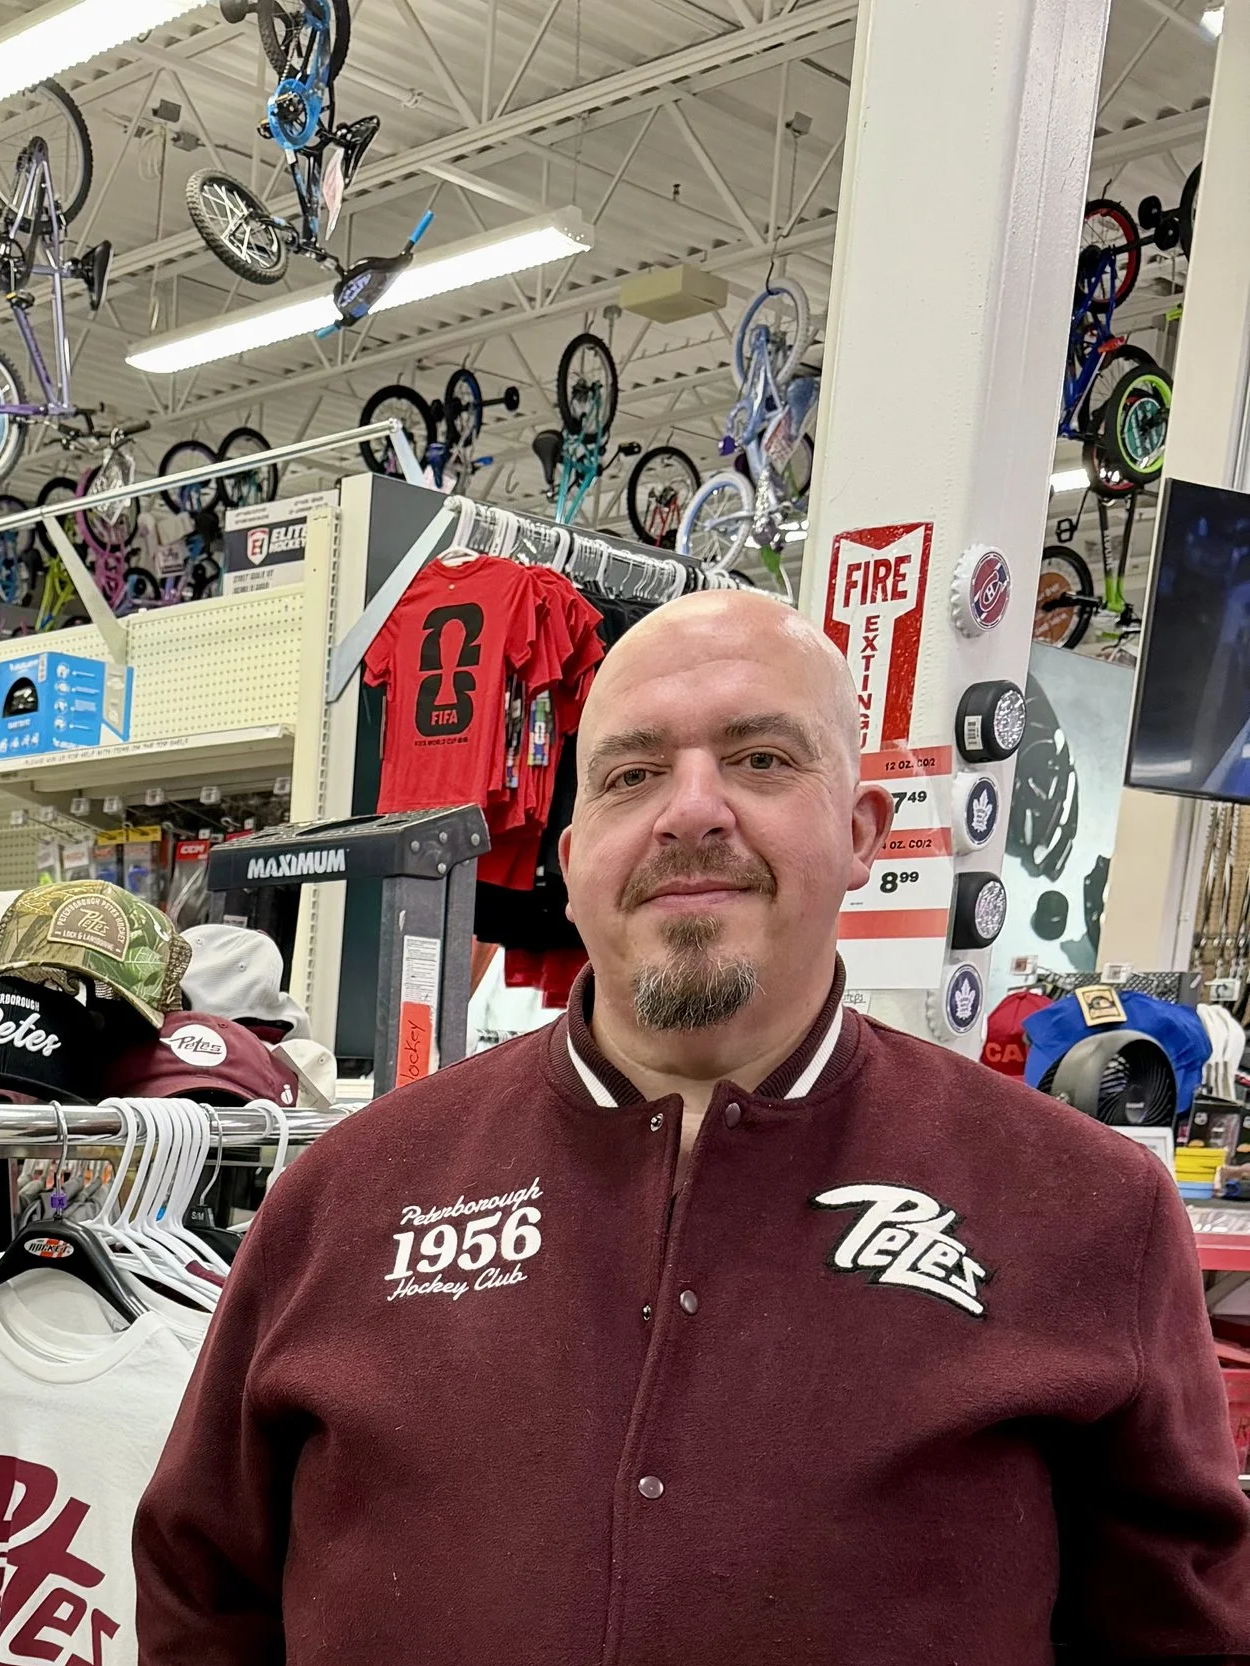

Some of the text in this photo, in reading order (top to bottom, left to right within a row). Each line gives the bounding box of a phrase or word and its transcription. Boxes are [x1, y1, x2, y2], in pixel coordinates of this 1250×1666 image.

[843, 554, 912, 608] FIRE
[430, 709, 458, 726] FIFA
[885, 762, 896, 772] 12
[898, 760, 914, 770] OZ.
[890, 839, 932, 850] OZ. CO/2
[247, 849, 347, 879] MAXIMUM
[57, 897, 100, 926] PETERBOROUGH
[400, 1177, 543, 1226] Peterborough
[384, 1206, 542, 1281] 1956
[813, 1183, 988, 1316] Petes
[387, 1263, 527, 1301] Hockey Club
